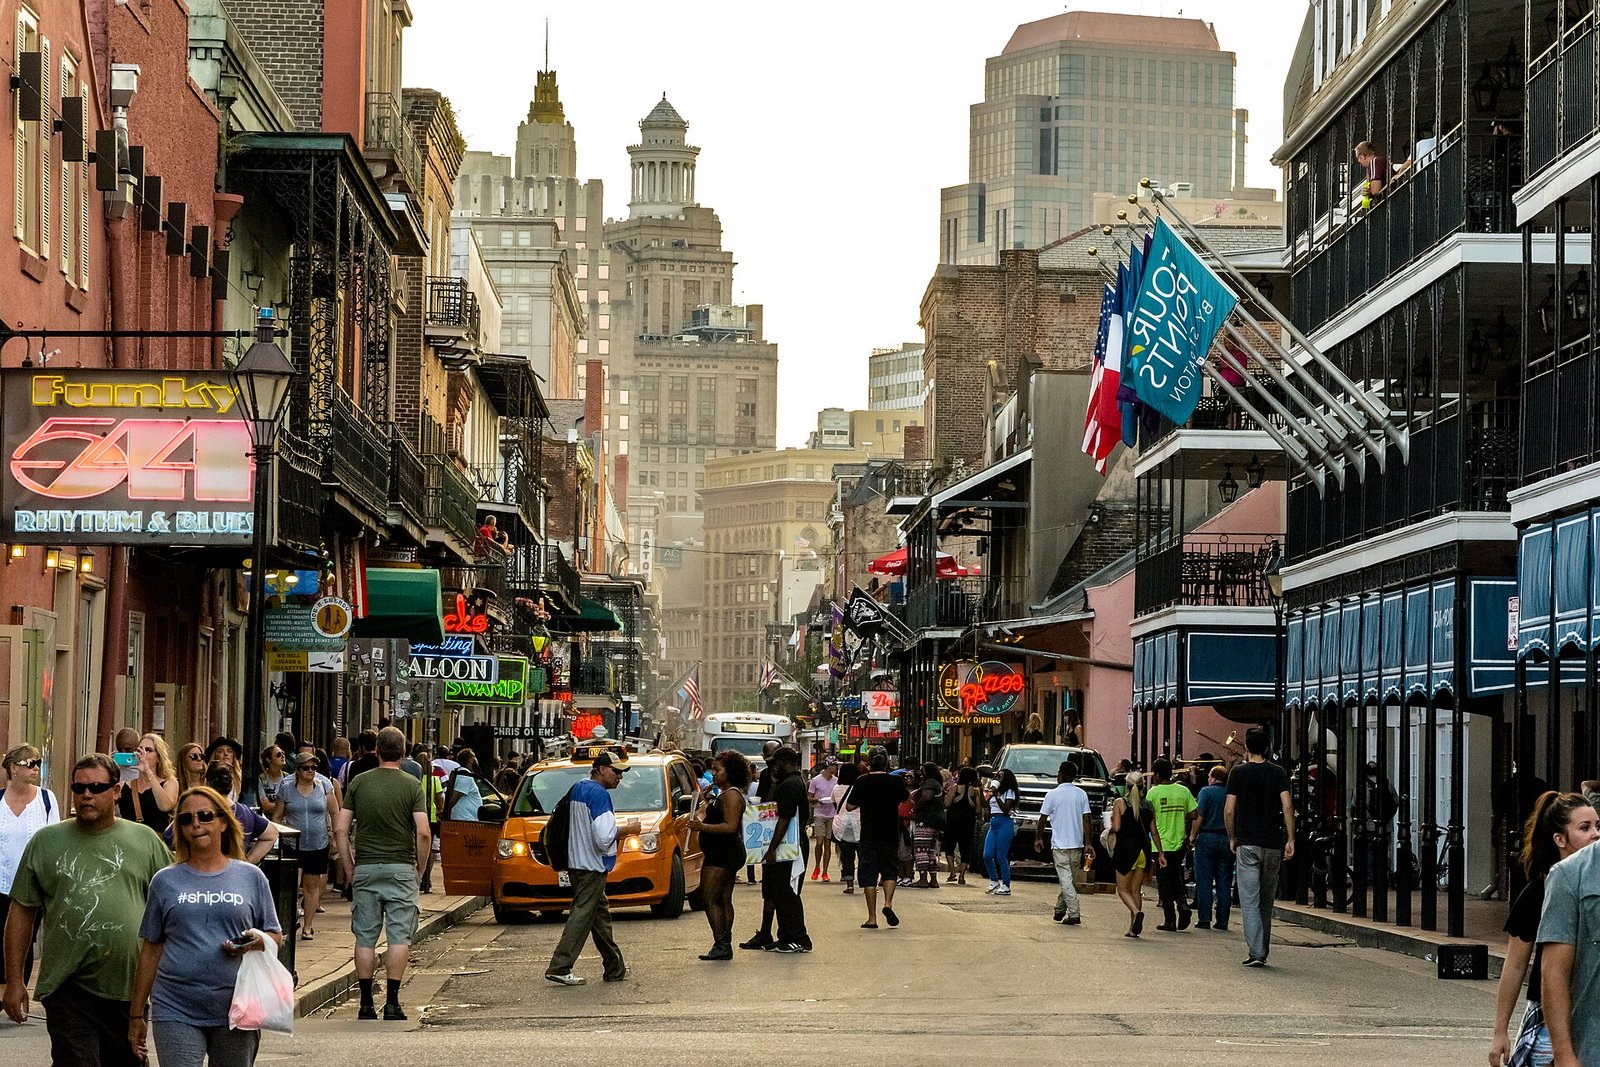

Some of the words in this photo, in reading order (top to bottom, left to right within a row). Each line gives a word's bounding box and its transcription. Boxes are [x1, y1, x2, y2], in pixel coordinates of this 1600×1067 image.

[31, 374, 241, 414] Funky
[10, 417, 254, 503] 544
[14, 510, 143, 533] RHYTHM
[147, 511, 172, 533] &
[642, 531, 650, 581] ASTOR
[663, 549, 680, 558] AC
[444, 593, 488, 633] cks
[408, 656, 488, 680] ALOON
[447, 680, 523, 700] SWAMP
[982, 704, 994, 712] CLUB
[1001, 694, 1015, 709] PATIO
[571, 720, 603, 730] EAFOOD
[973, 716, 1001, 724] DINING
[493, 727, 520, 736] CHRIS
[745, 822, 763, 849] 2
[177, 890, 244, 907] #shiplap
